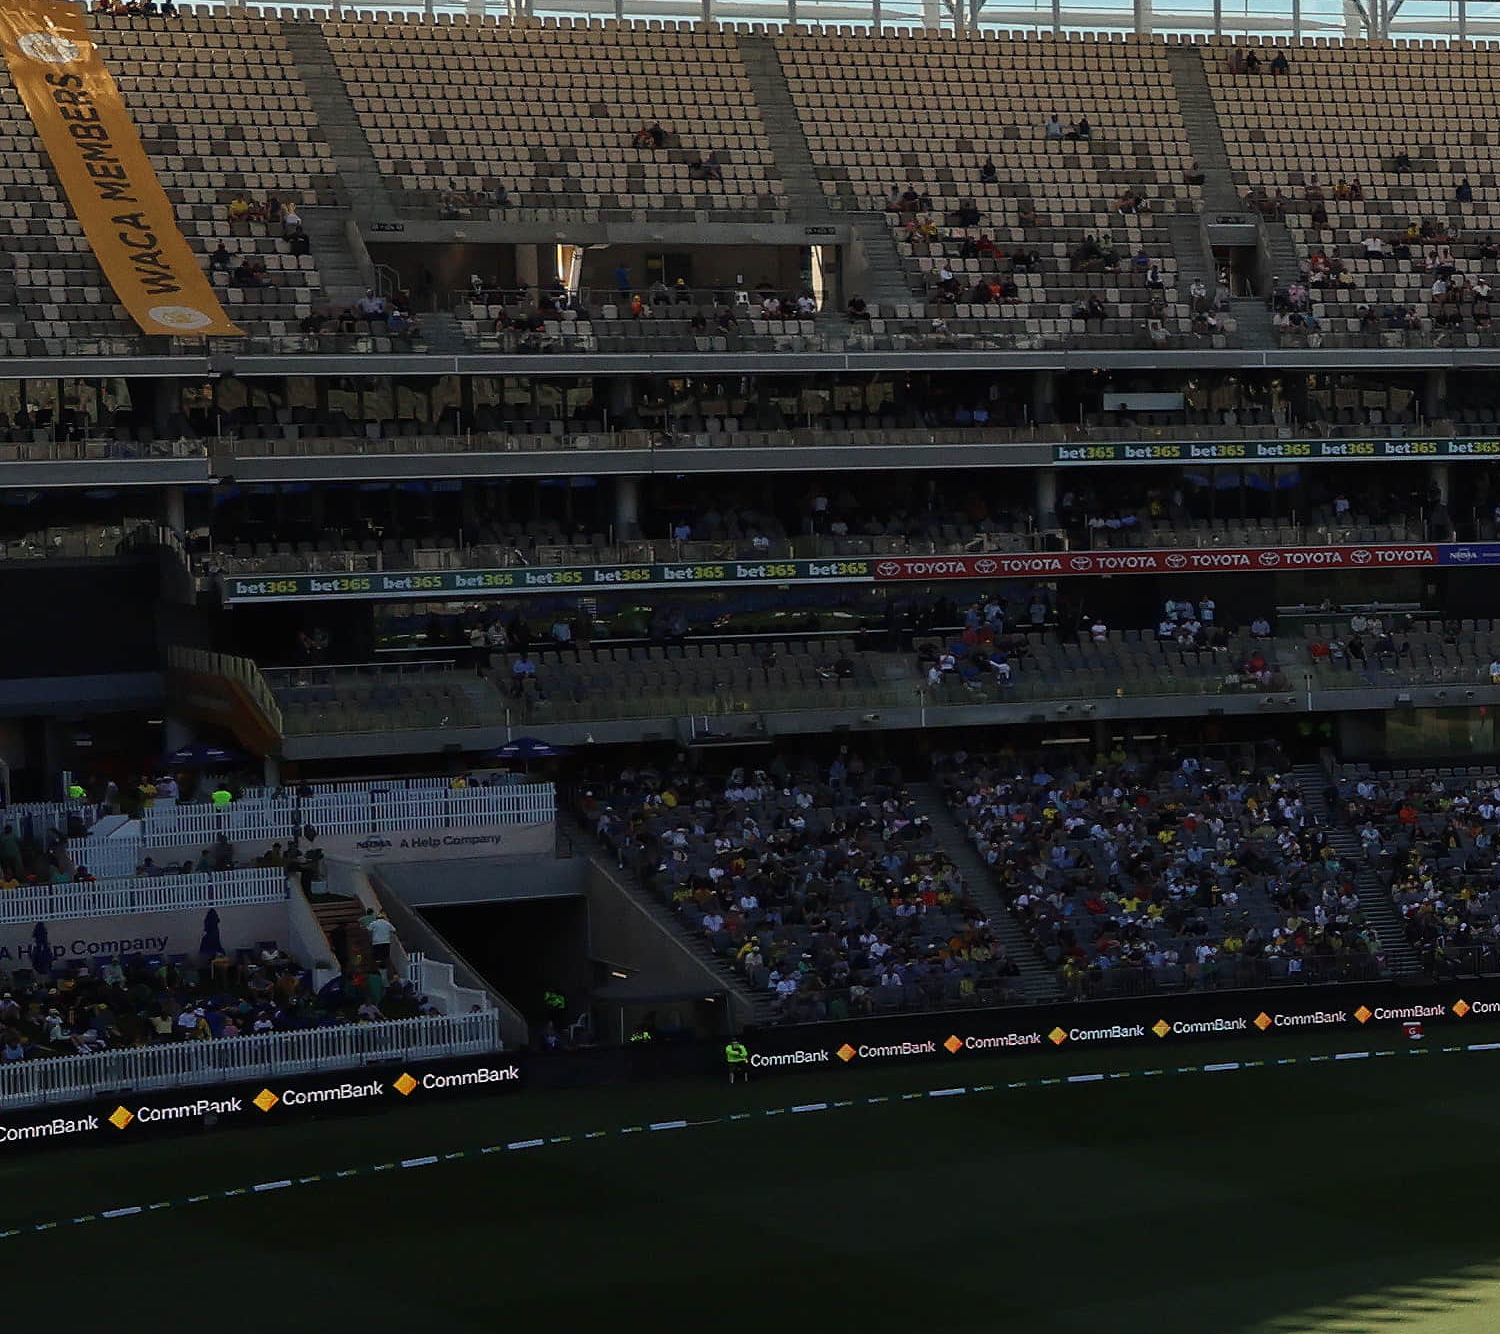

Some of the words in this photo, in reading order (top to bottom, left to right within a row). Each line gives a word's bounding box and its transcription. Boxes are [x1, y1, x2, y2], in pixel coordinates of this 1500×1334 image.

[45, 73, 138, 203] MEMBERS
[110, 212, 182, 295] WACA
[1059, 447, 1115, 460] bet365
[1191, 445, 1246, 457] bet365
[1257, 444, 1311, 456] bet365
[1385, 442, 1438, 454] bet365
[1448, 441, 1500, 453] bet365
[1096, 556, 1156, 568] TOYOTA
[1191, 554, 1250, 565] TOYOTA
[1376, 549, 1432, 562] TOYOTA
[664, 567, 725, 579] bet365
[809, 562, 867, 575] bet365
[904, 562, 966, 574] TOYOTA
[383, 577, 441, 588] bet365
[526, 571, 583, 584] bet365
[237, 581, 297, 594] bet365
[400, 838, 410, 849] A
[412, 837, 441, 849] Help
[443, 834, 502, 847] Company
[0, 946, 13, 960] A
[71, 935, 169, 954] Company
[1274, 1010, 1346, 1026] CommBank
[1374, 1004, 1445, 1019] CommBank
[1070, 1023, 1144, 1041] CommBank
[1173, 1018, 1246, 1034] CommBank
[965, 1032, 1041, 1049] CommBank
[859, 1041, 936, 1058] CommBank
[751, 1049, 828, 1067] CommBank
[422, 1064, 519, 1089] CommBank
[282, 1080, 383, 1105] CommBank
